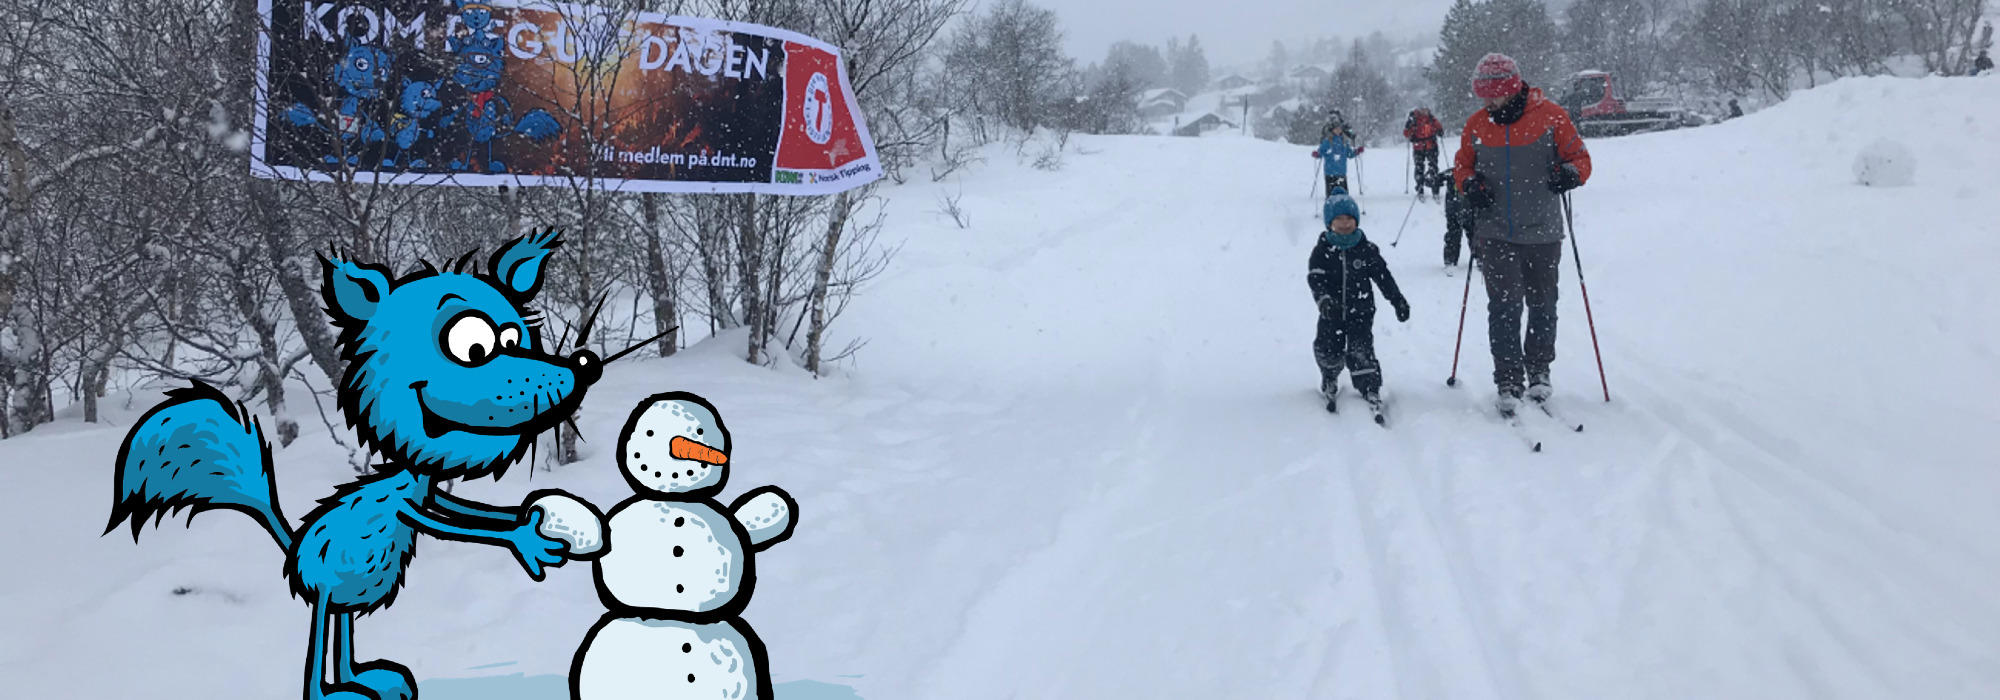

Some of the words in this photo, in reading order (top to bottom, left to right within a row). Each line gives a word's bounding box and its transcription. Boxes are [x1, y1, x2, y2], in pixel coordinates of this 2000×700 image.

[303, 1, 427, 50] KOM
[639, 35, 769, 80] DAGEN
[597, 146, 614, 162] li
[618, 144, 684, 165] medlem
[688, 149, 708, 170] på
[711, 149, 757, 168] dnt.no
